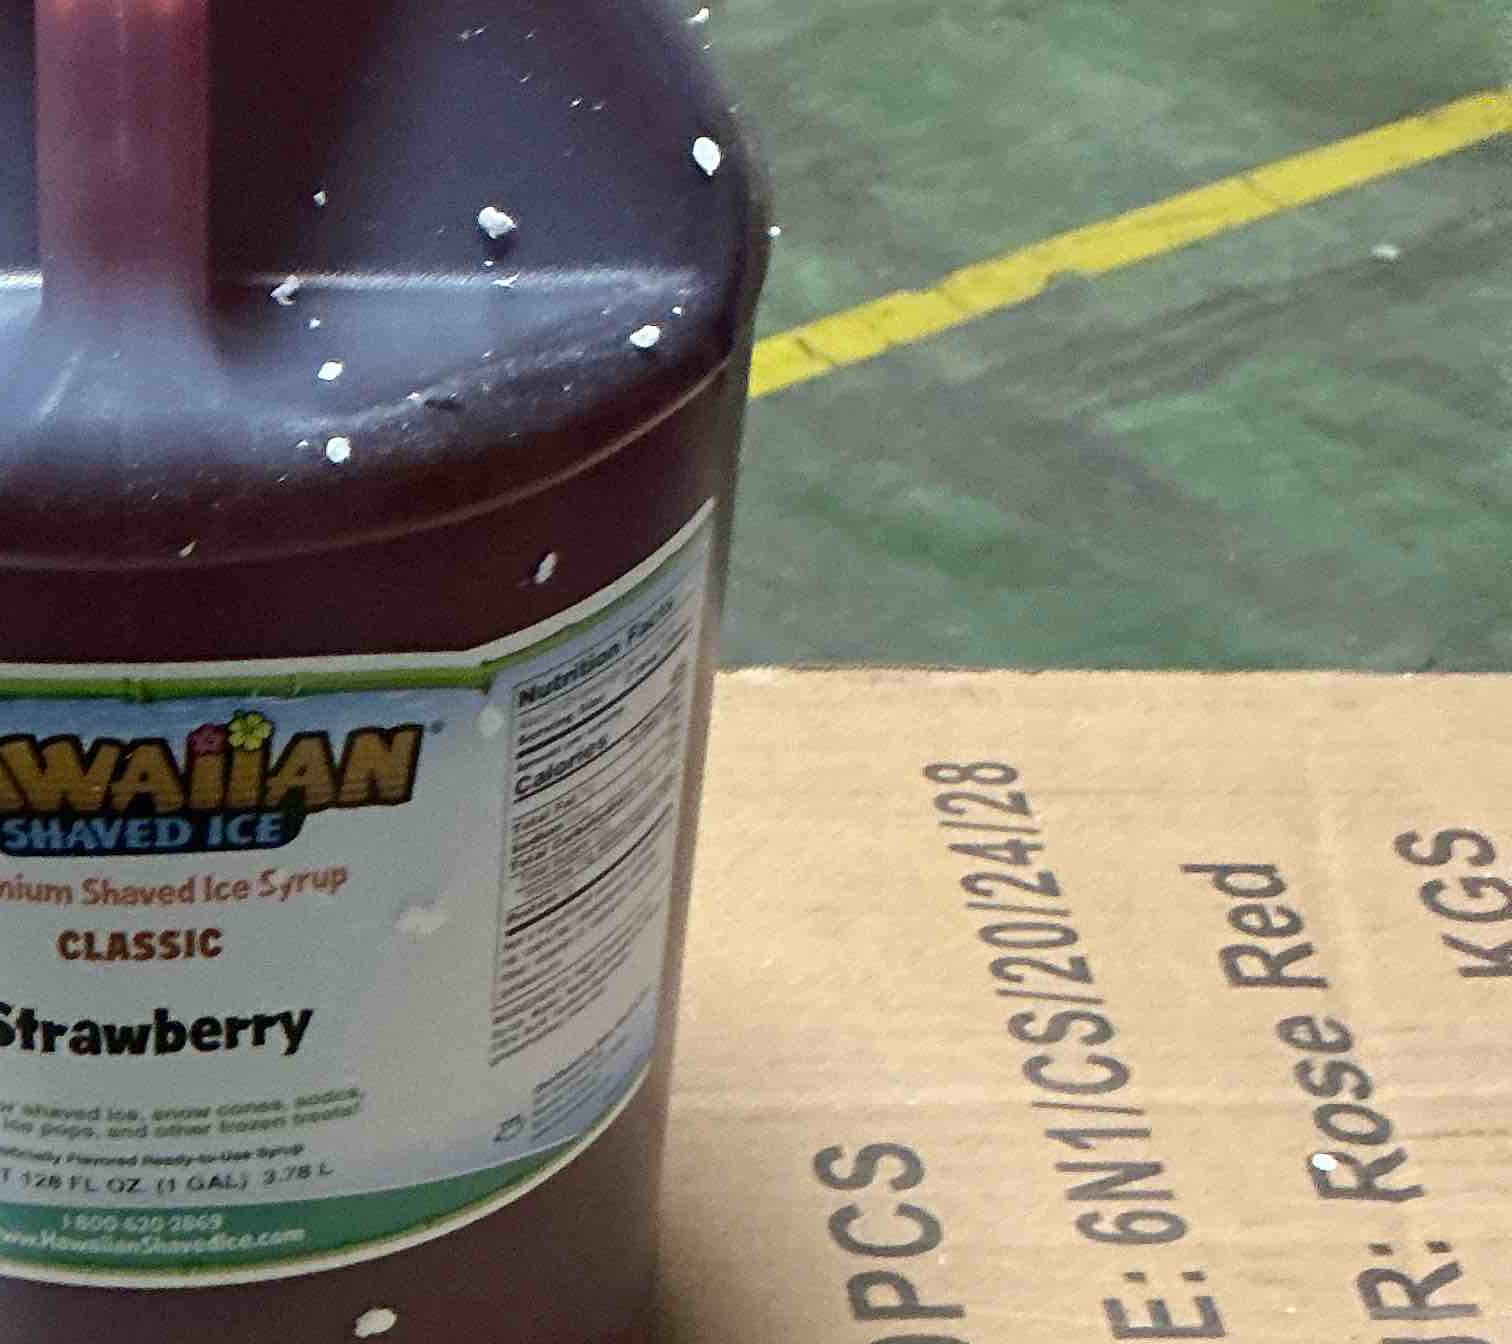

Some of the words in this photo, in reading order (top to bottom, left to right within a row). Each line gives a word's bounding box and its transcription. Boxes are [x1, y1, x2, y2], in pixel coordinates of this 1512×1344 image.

[0, 813, 192, 851] SHAVED
[207, 811, 285, 846] ICE
[81, 871, 195, 906] Shaved
[202, 874, 249, 902] Ice
[257, 864, 348, 902] Syrup
[1179, 863, 1329, 991] Red
[55, 927, 225, 962] CLASSIC
[921, 759, 1188, 1247] 6N1/CS/20/24/28
[1275, 1013, 1424, 1204] Rose
